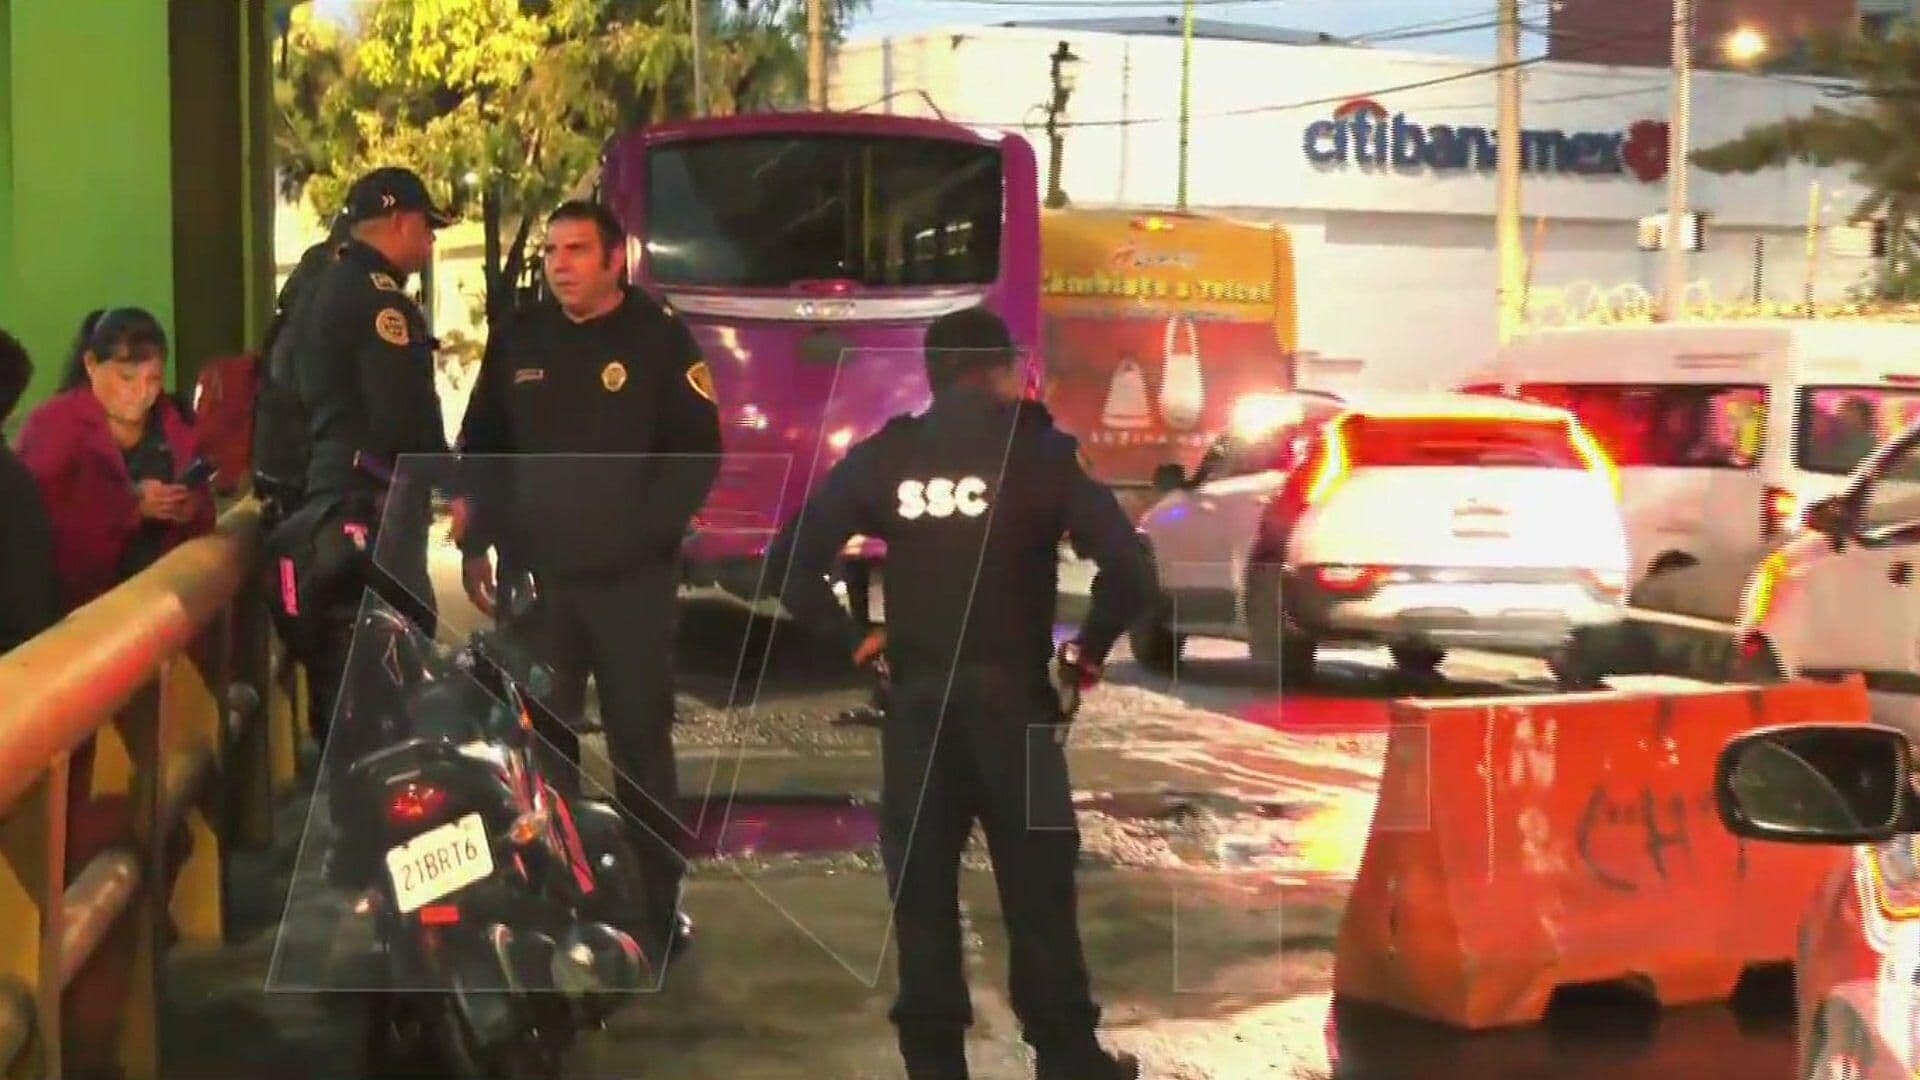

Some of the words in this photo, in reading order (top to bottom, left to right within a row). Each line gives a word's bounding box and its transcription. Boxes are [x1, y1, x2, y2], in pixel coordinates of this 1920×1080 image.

[1303, 107, 1624, 170] citibanmex
[897, 476, 988, 519] SSC
[400, 837, 478, 892] 21BRT6
